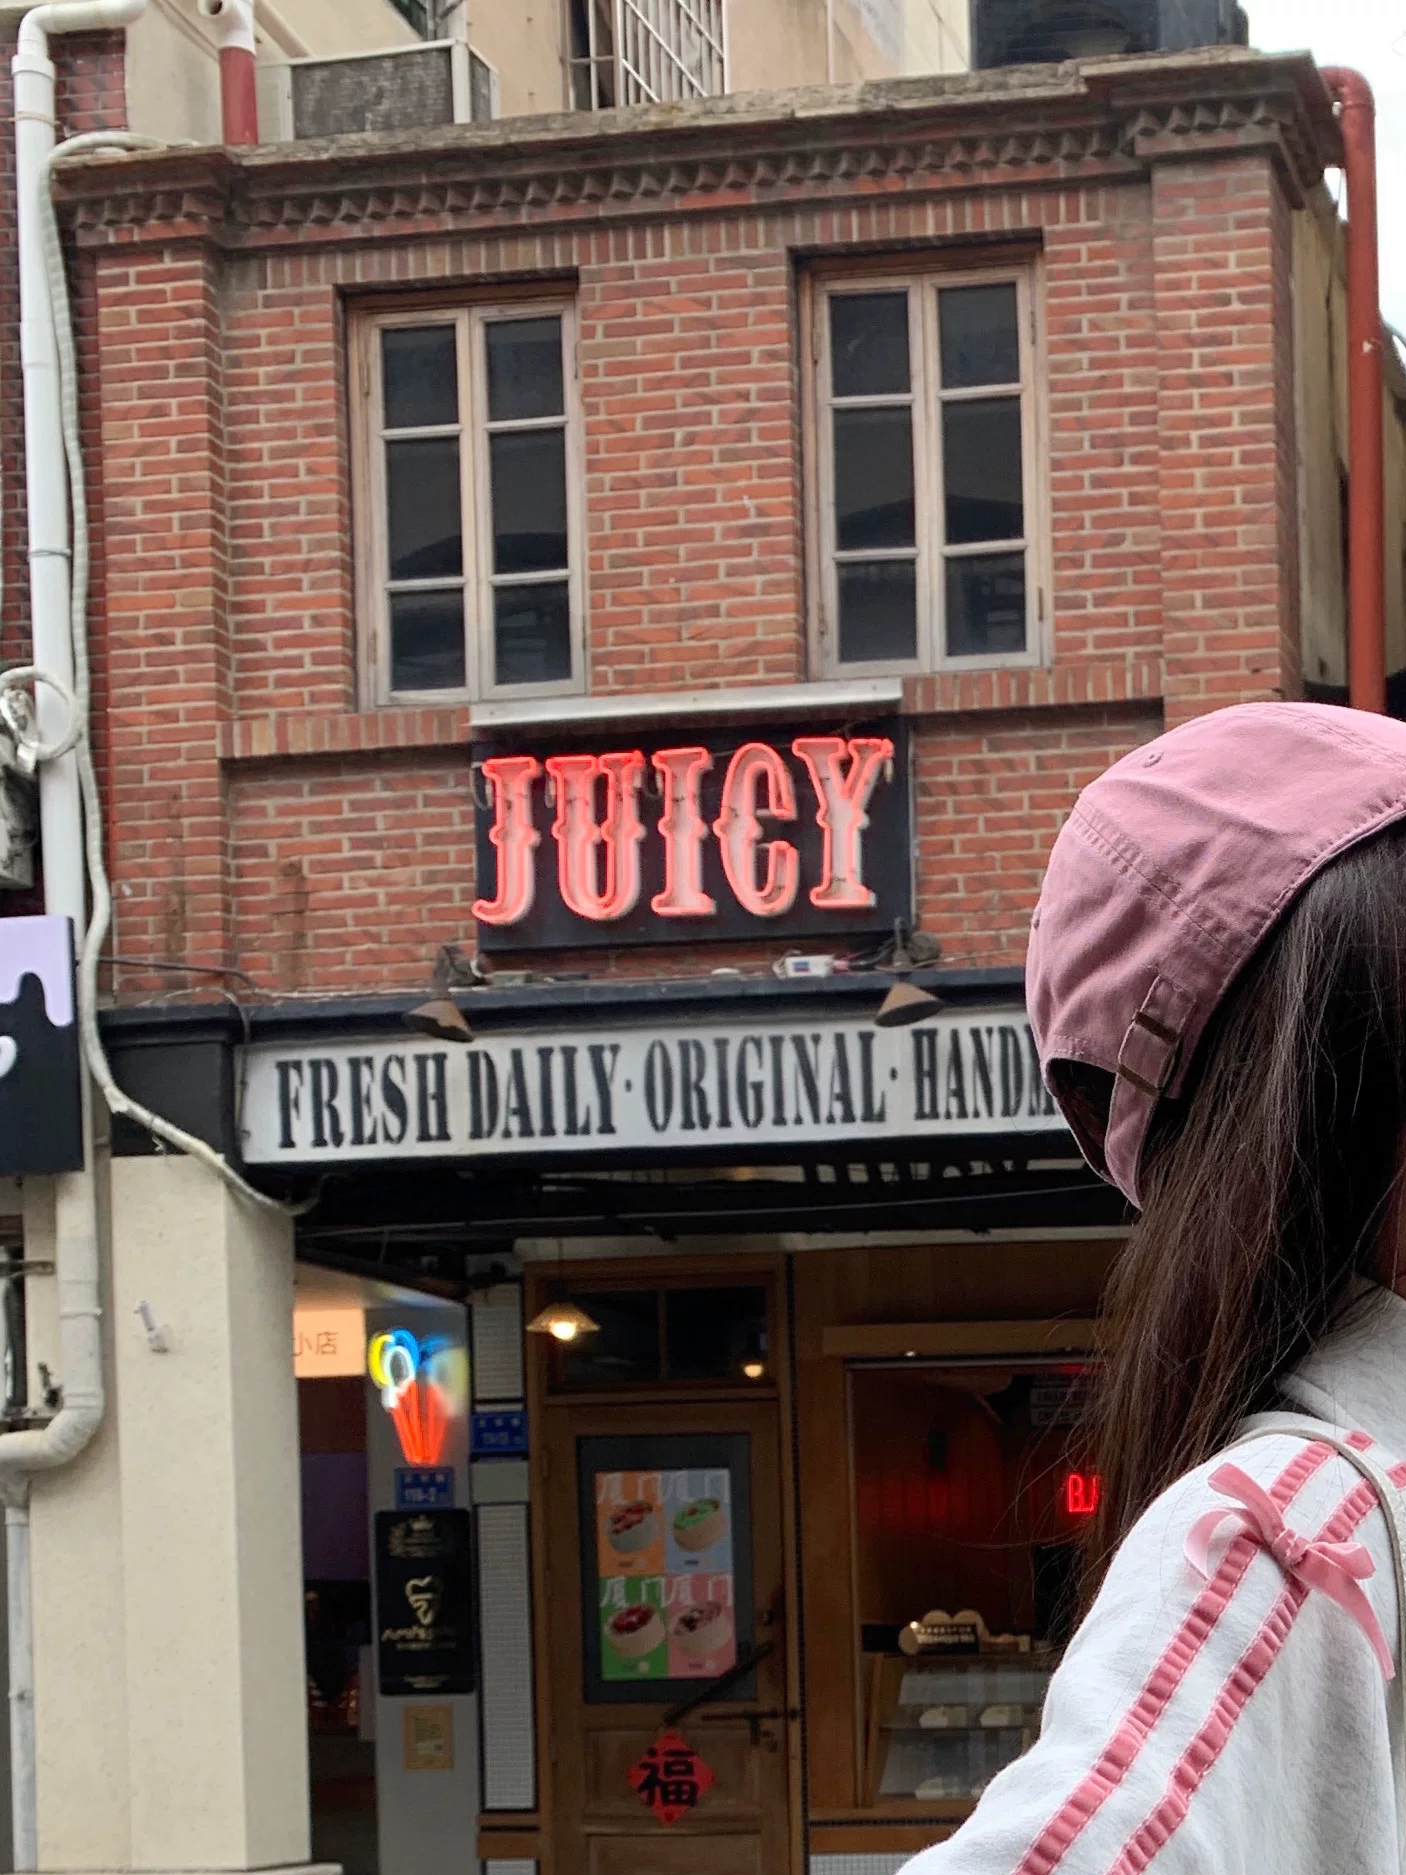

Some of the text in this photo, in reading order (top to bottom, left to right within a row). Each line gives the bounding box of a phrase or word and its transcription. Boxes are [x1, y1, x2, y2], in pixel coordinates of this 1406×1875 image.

[471, 736, 894, 926] JUICY
[275, 1052, 452, 1149] FRESH
[466, 1043, 621, 1140] DAILY
[644, 1030, 887, 1133] ORIGINAL
[638, 1747, 698, 1808] 福
